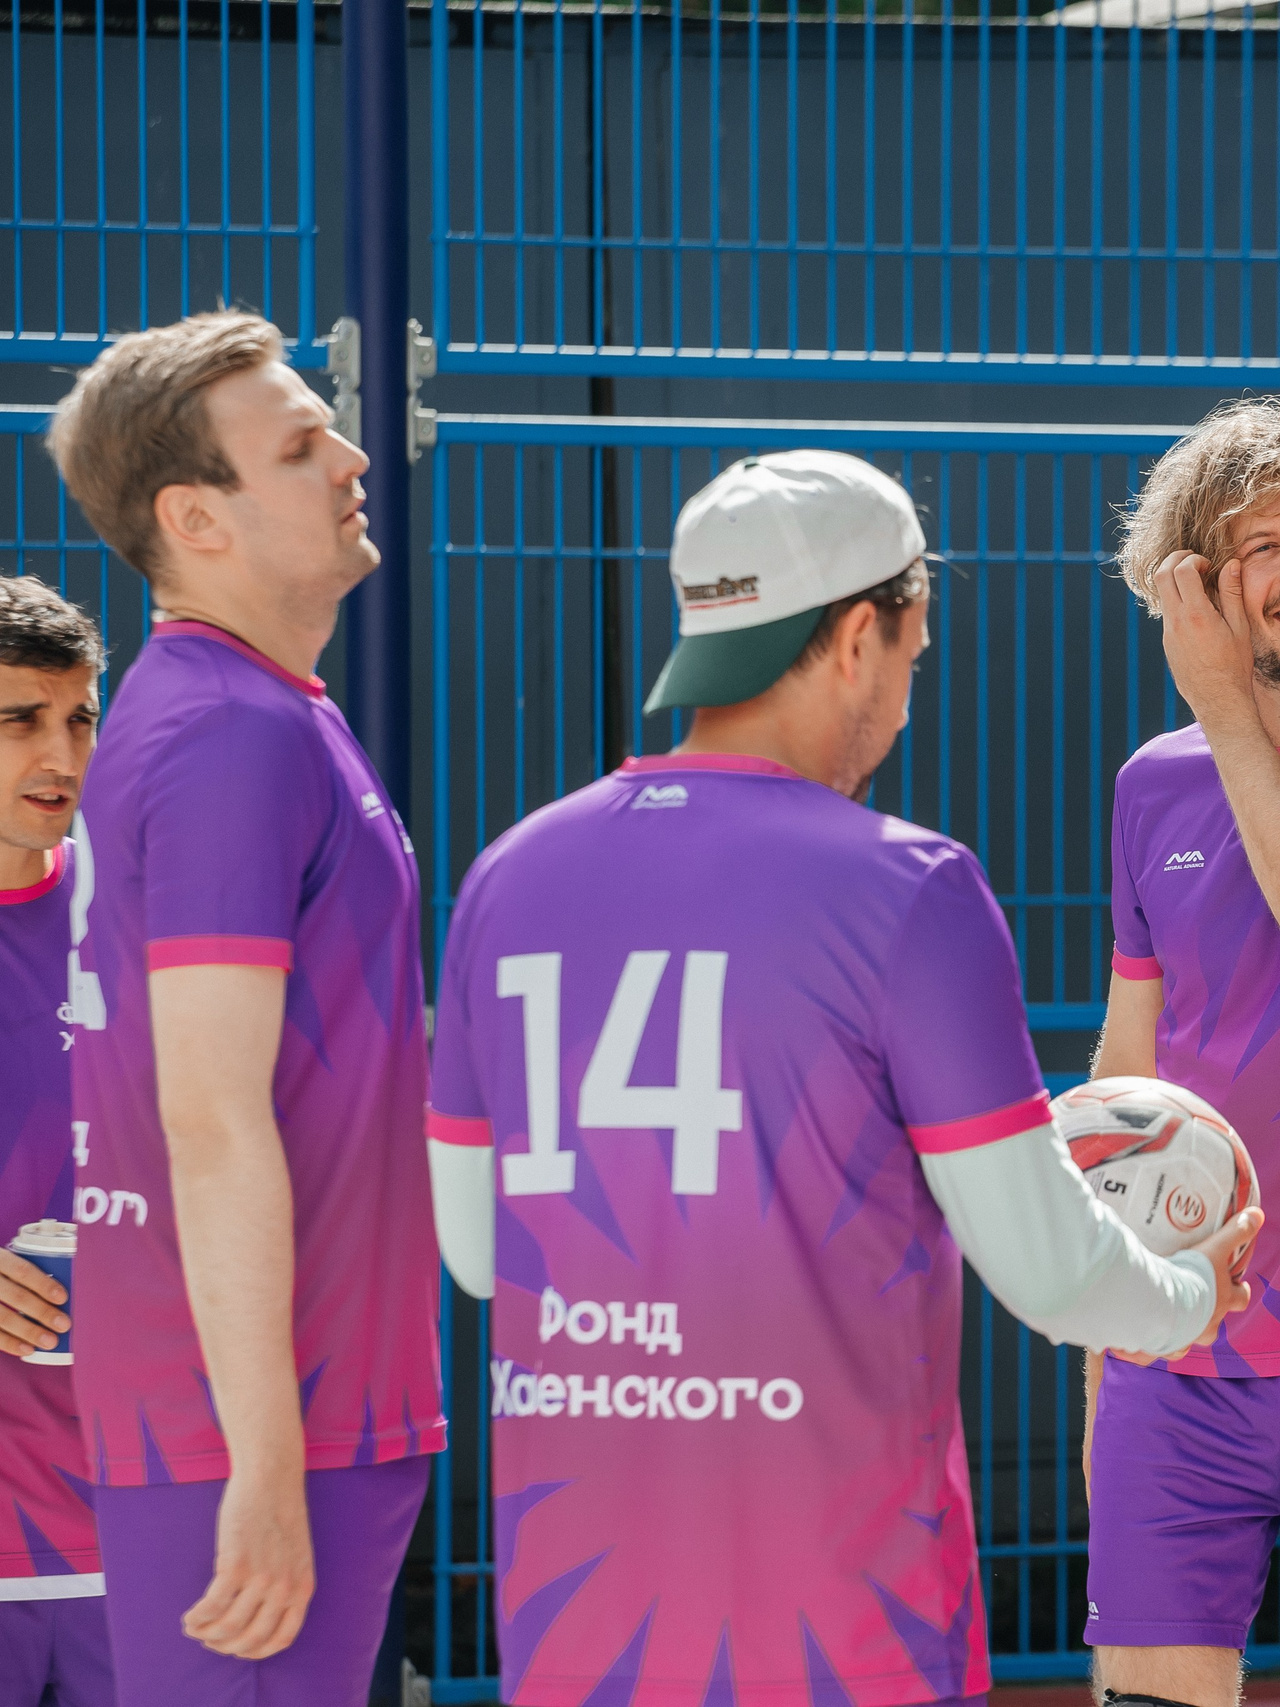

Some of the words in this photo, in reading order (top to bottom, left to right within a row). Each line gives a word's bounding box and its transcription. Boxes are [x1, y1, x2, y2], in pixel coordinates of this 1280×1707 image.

[496, 950, 743, 1196] 14
[1104, 1180, 1127, 1195] 5
[538, 1286, 683, 1356] Фонд
